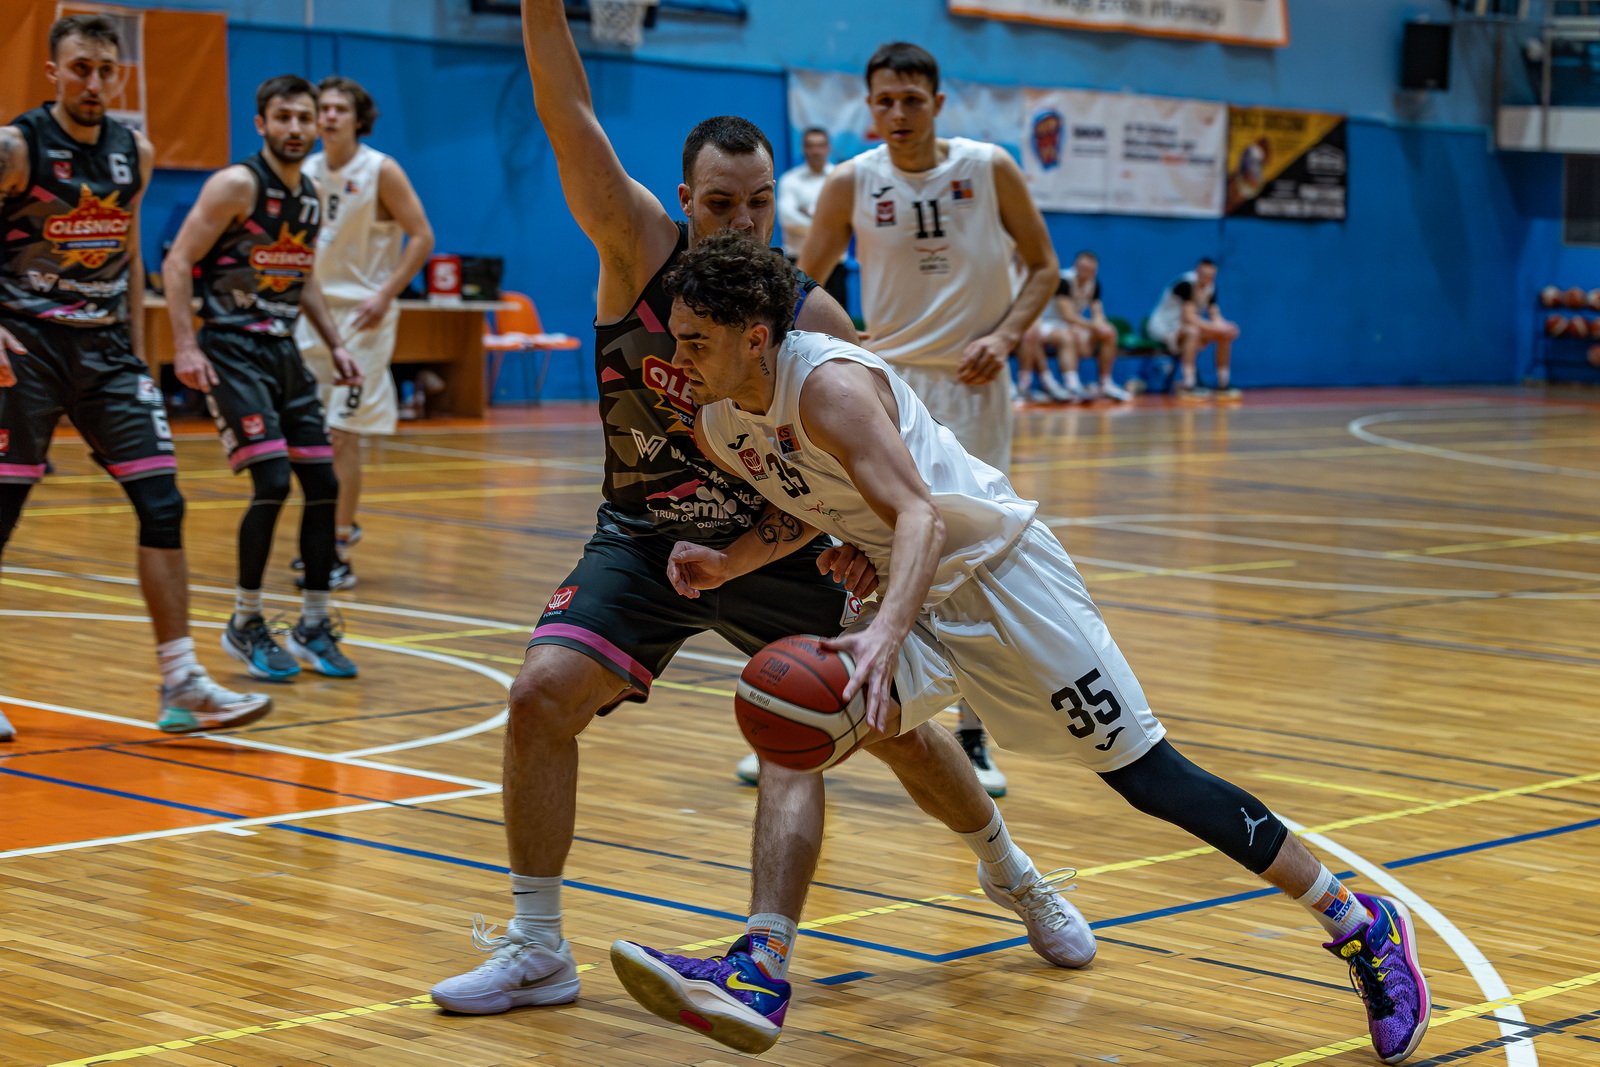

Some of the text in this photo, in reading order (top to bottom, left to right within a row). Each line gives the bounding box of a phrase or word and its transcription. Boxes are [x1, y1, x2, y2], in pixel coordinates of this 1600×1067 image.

[107, 152, 134, 184] 6
[299, 196, 320, 225] 77
[911, 199, 946, 239] 11
[650, 366, 697, 407] OLE
[1050, 667, 1121, 739] 35
